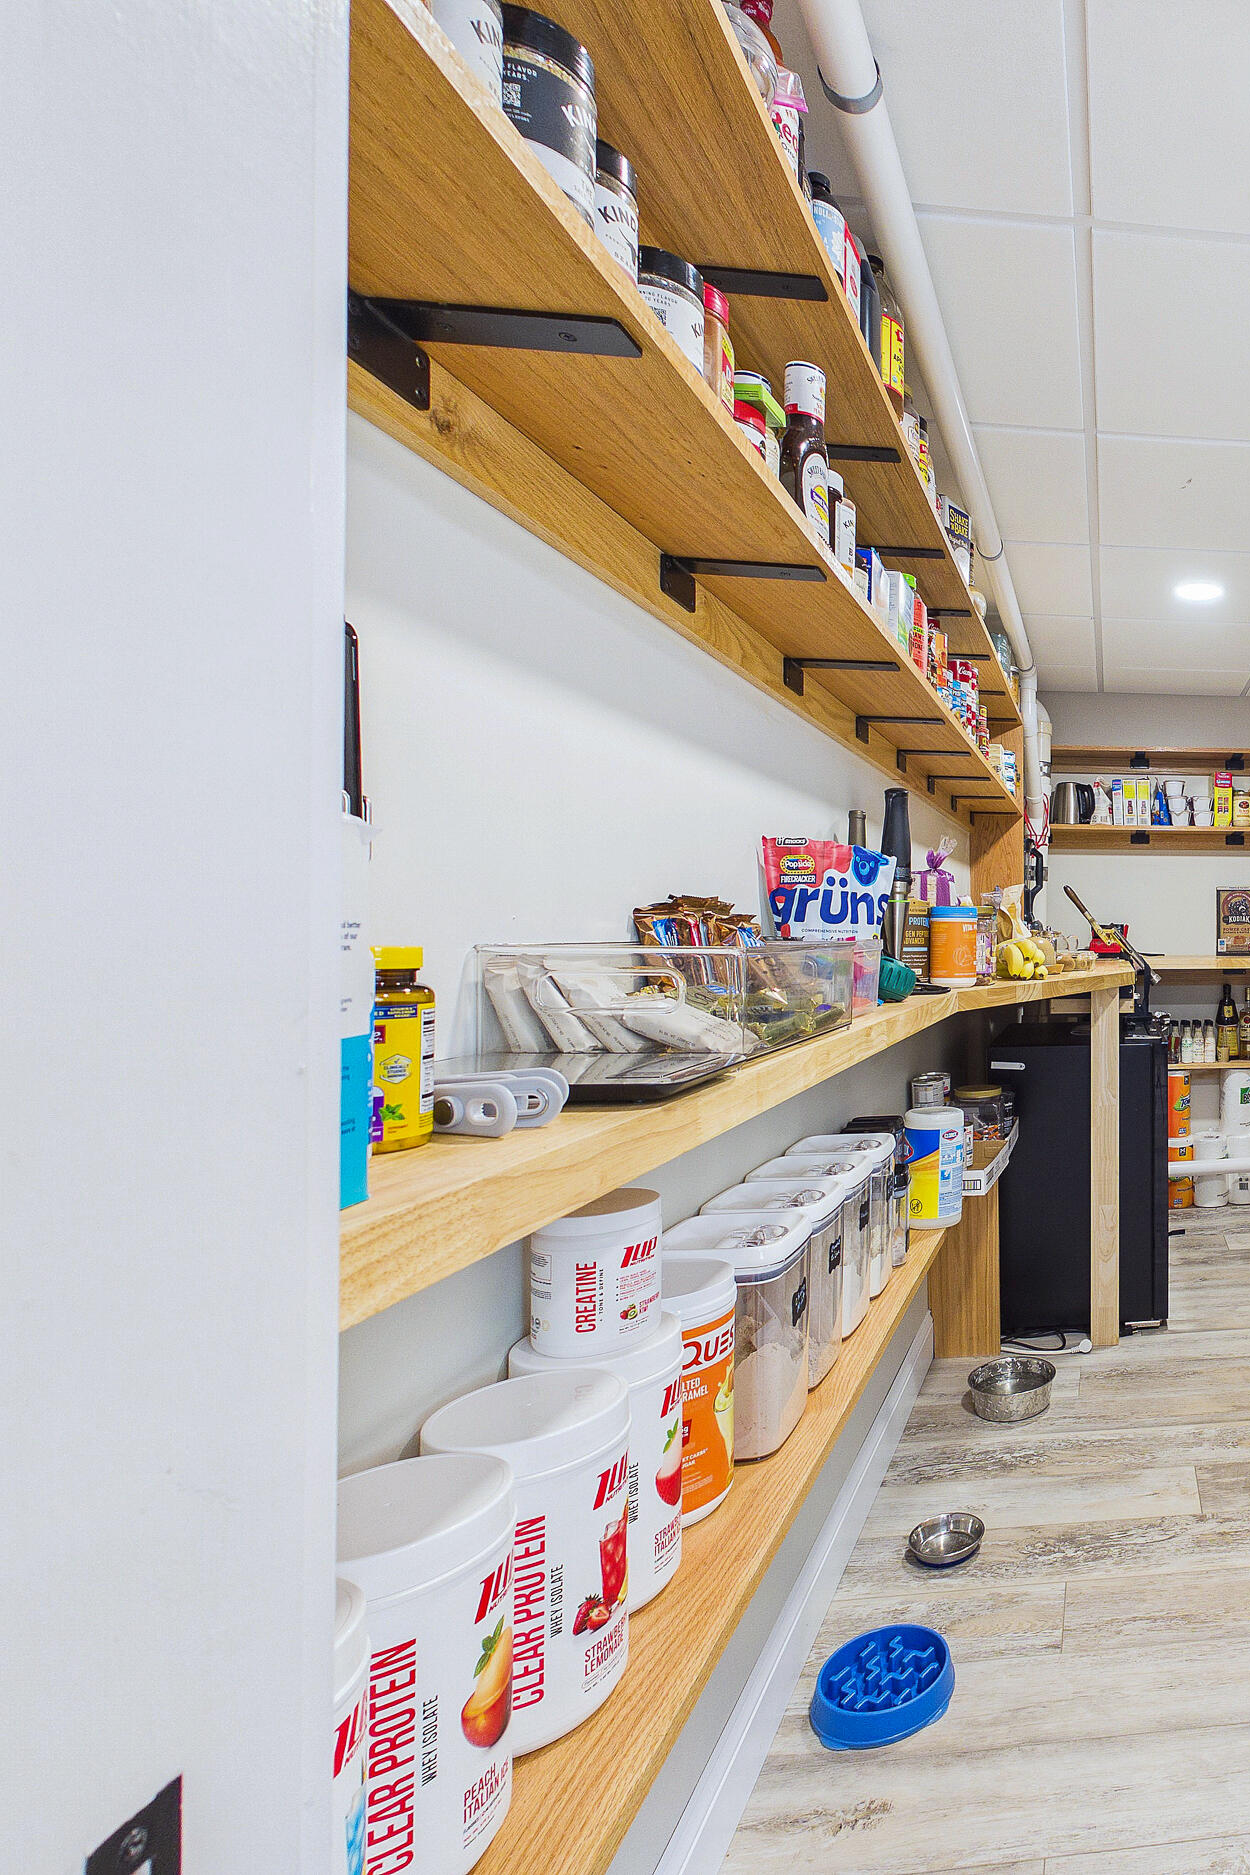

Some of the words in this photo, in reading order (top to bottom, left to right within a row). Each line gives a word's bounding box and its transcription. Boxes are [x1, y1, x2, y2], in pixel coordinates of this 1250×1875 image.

[949, 508, 969, 528] SHAKE
[955, 523, 969, 538] BAKE
[769, 875, 891, 932] grüns
[1228, 915, 1250, 923] KODIAK
[575, 1261, 597, 1334] CREATINE
[682, 1325, 735, 1370] QUES
[628, 1462, 639, 1497] ISOLATE
[628, 1498, 639, 1525] WHEY
[513, 1515, 546, 1626] PROTEIN
[550, 1564, 563, 1605] ISOLATE
[550, 1607, 563, 1638] WHEY
[584, 1634, 624, 1677] LEMONADE
[368, 1638, 417, 1779] PROTEIN
[422, 1694, 439, 1748] ISOLATE
[421, 1748, 438, 1786] WHEY
[463, 1762, 496, 1808] PEACH
[463, 1773, 500, 1824] ITALIAN
